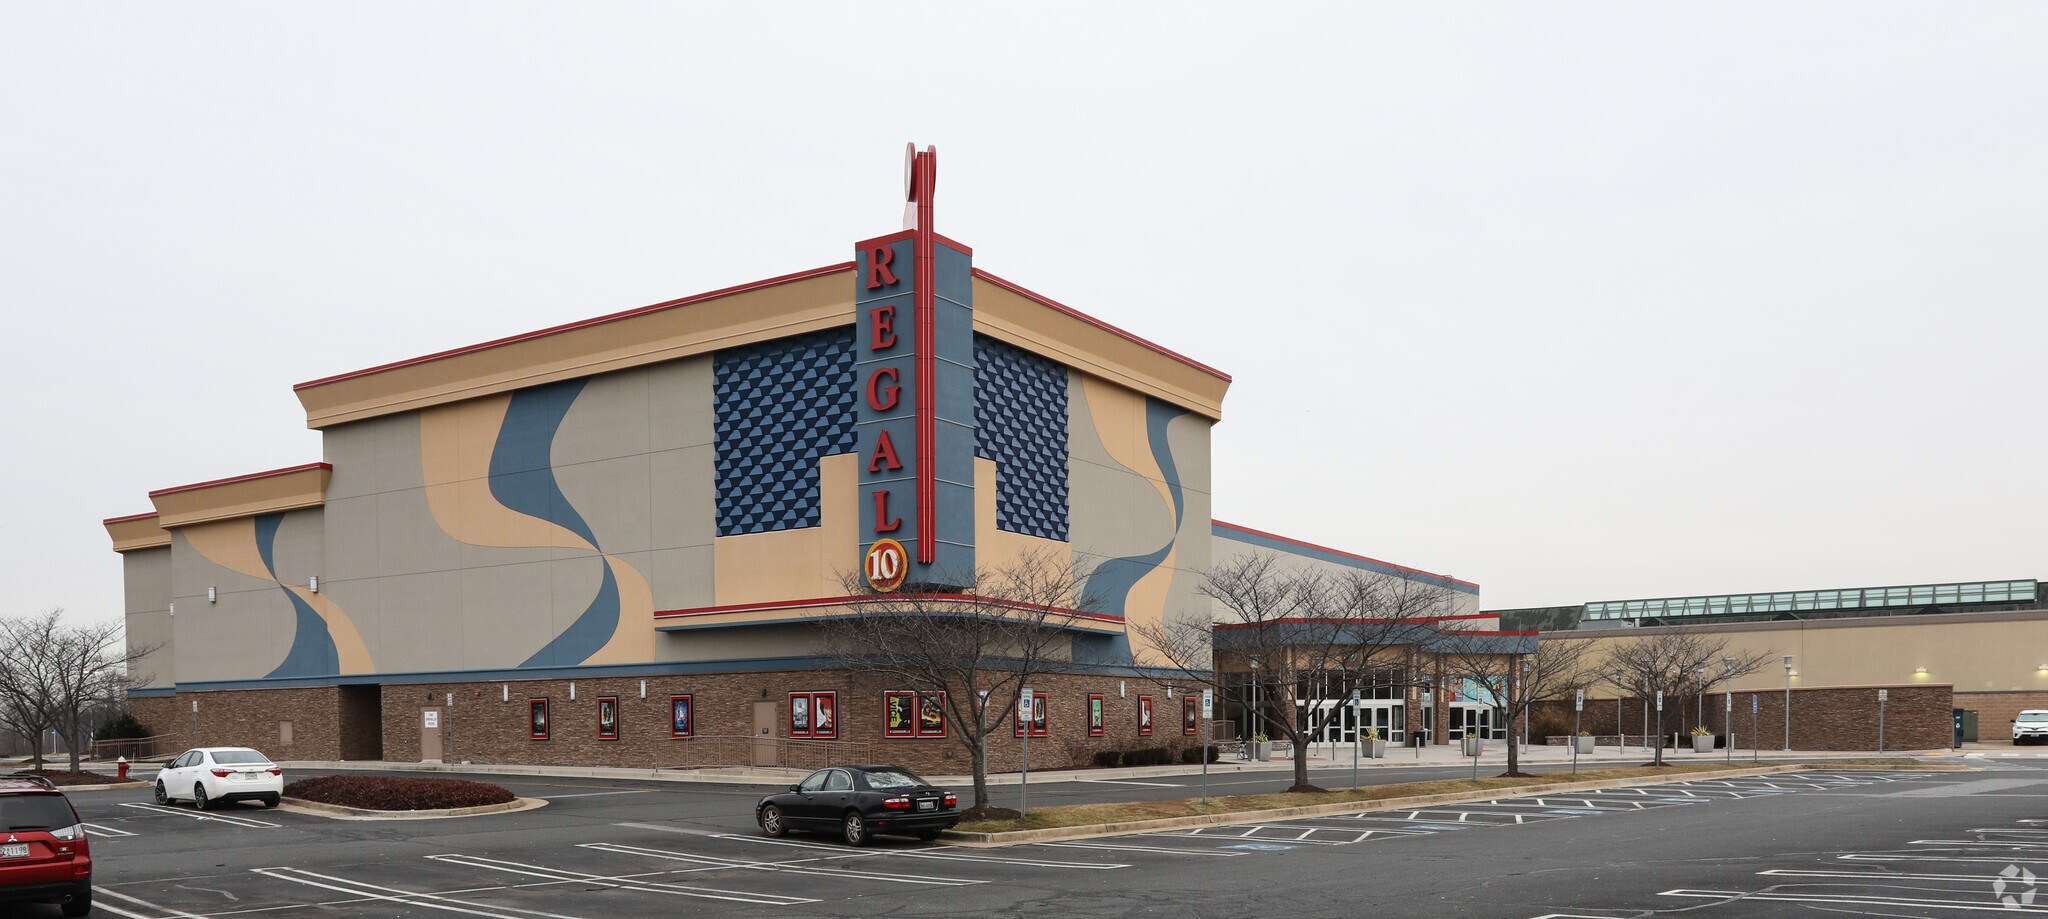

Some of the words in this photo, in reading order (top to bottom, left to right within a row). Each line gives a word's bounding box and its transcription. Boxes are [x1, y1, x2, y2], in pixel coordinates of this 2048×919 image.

[866, 244, 903, 533] REGAL
[870, 548, 899, 581] 10
[889, 701, 897, 722] VICE
